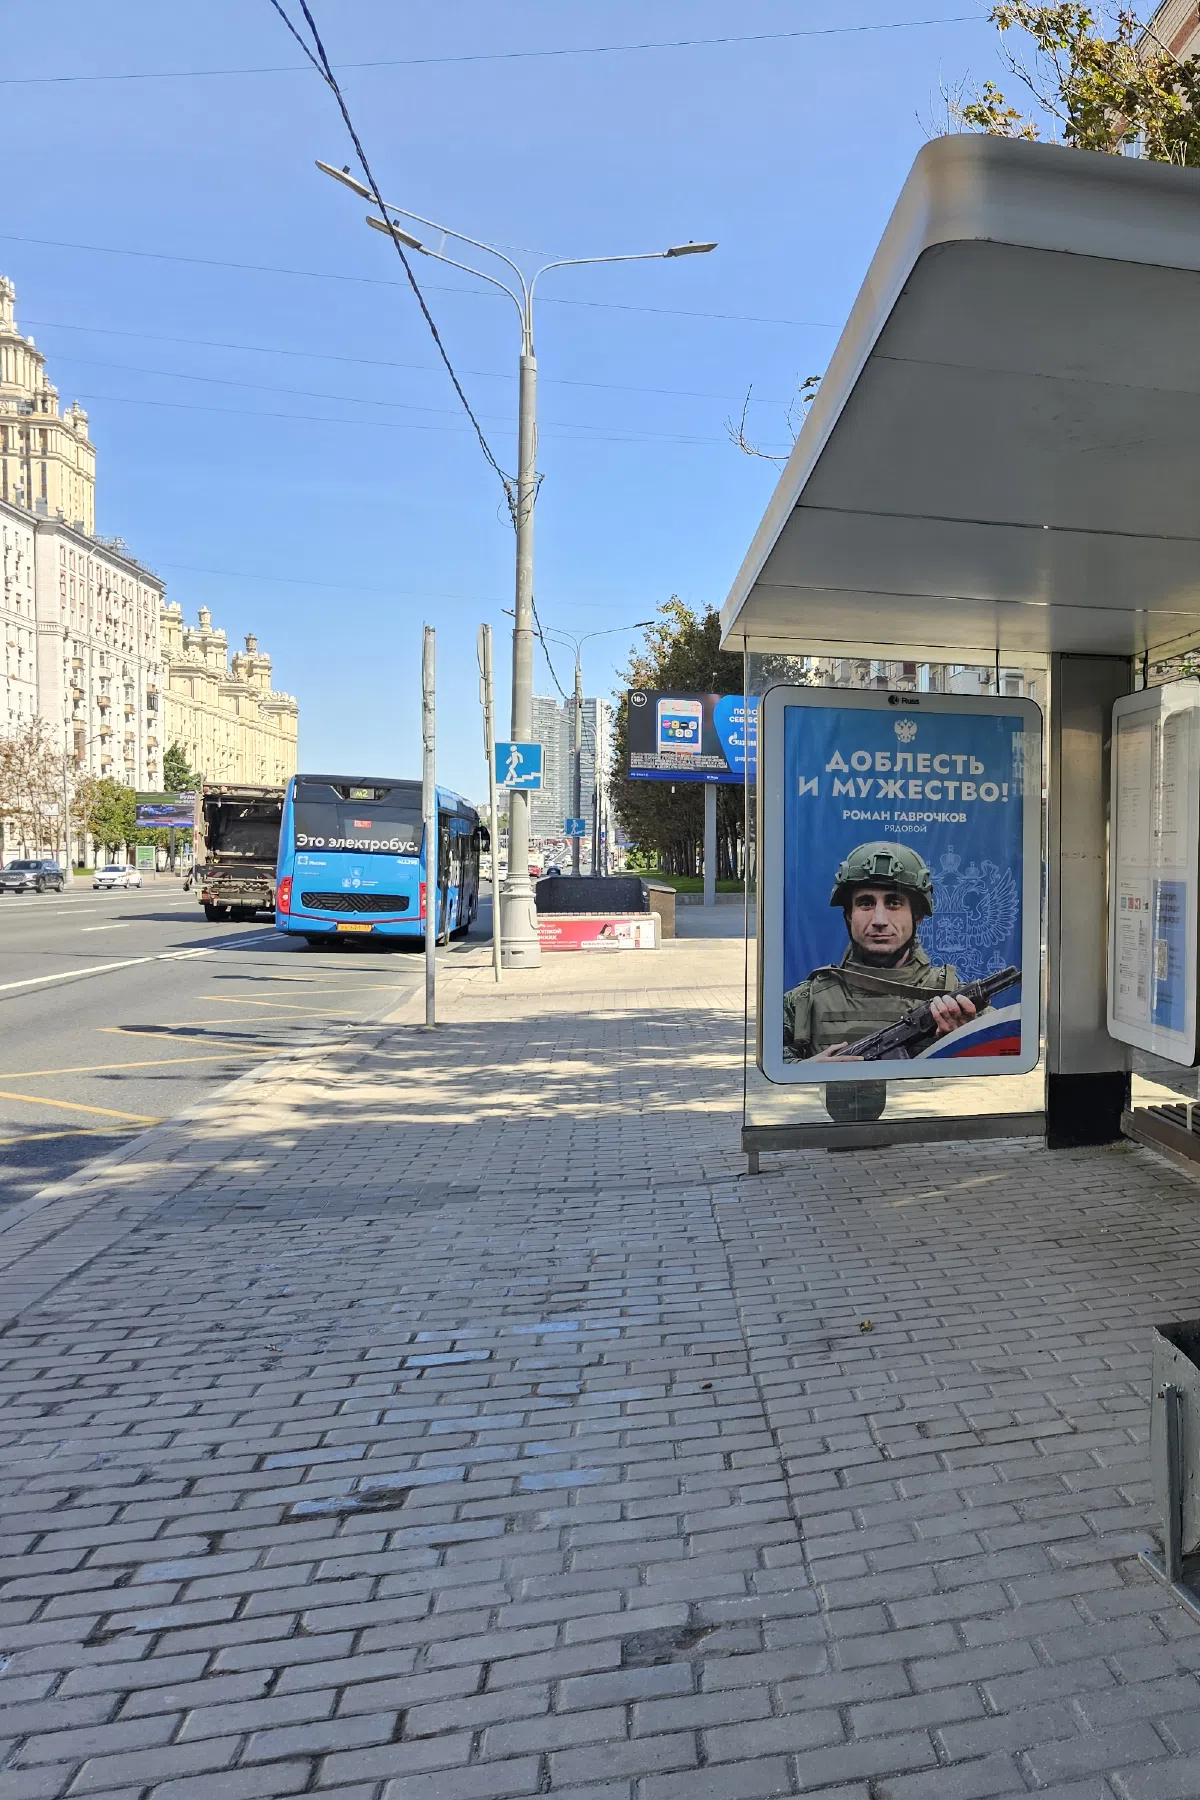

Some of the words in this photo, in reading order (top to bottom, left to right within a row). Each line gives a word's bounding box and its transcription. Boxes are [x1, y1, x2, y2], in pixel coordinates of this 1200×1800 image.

[825, 749, 985, 776] ДОБЛЕСТЬ
[798, 776, 819, 797] И
[832, 777, 1010, 803] МУЖЕСТВО!
[842, 809, 891, 821] РОМАН
[894, 811, 967, 824] ГАВРОЧКОВ
[884, 822, 927, 833] РЯДОВОЙ
[296, 833, 325, 847] Это
